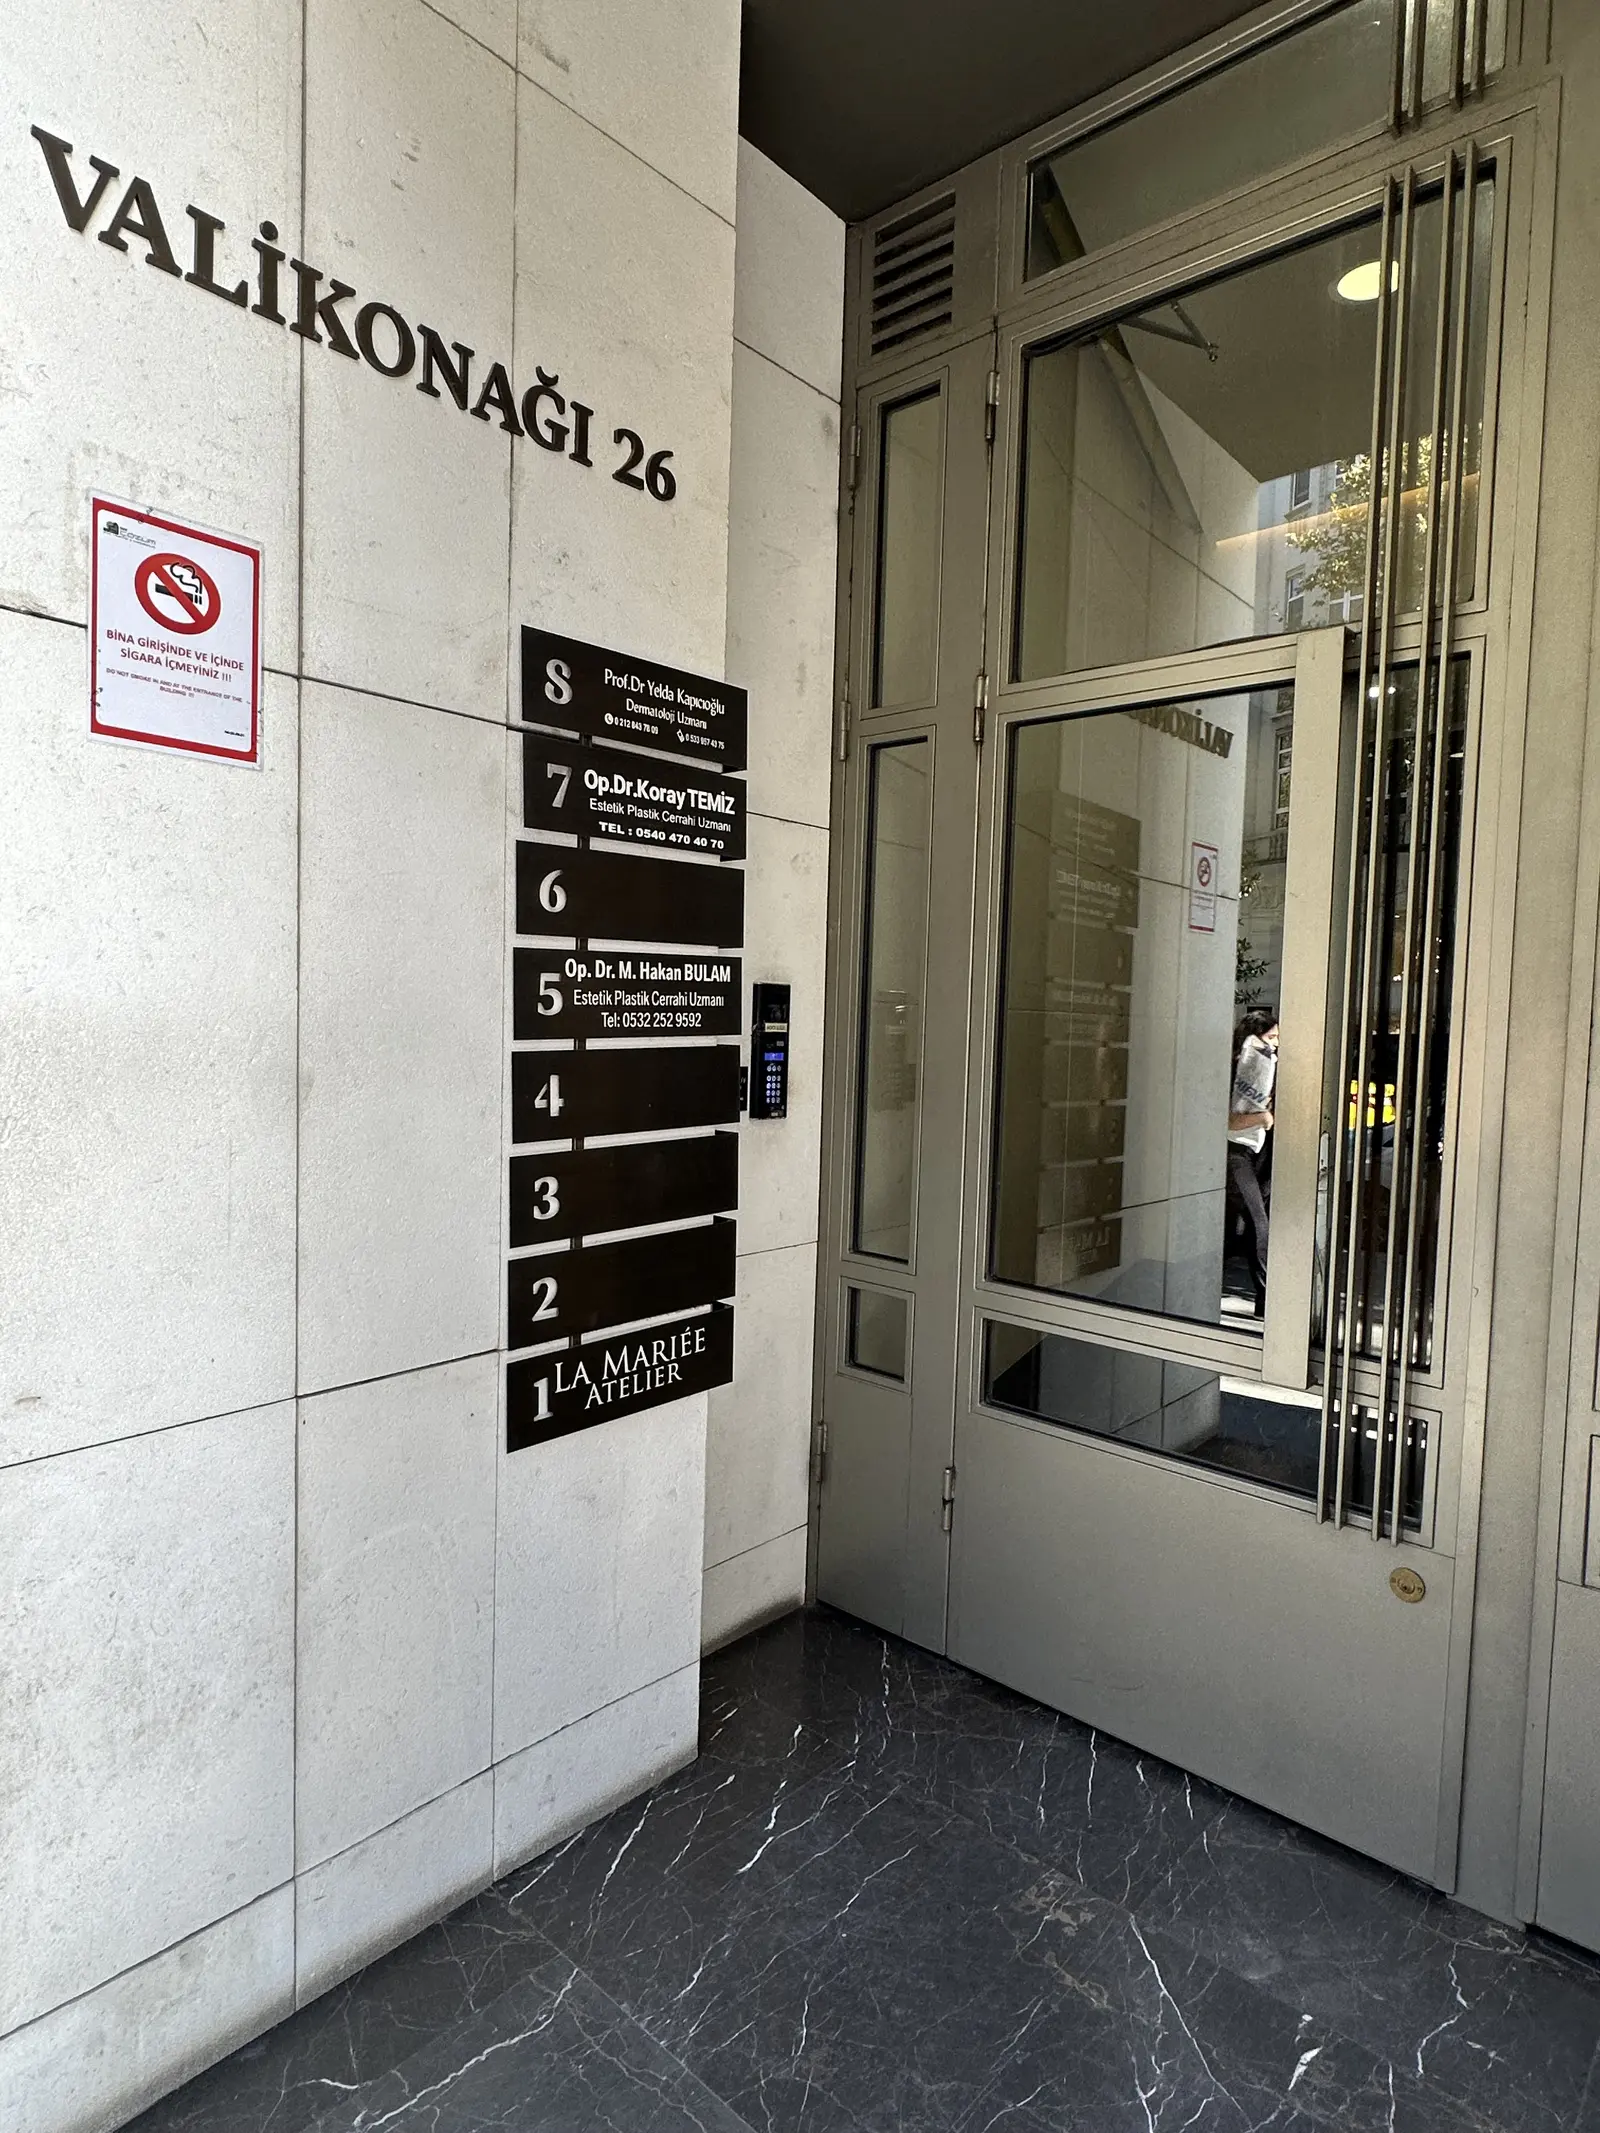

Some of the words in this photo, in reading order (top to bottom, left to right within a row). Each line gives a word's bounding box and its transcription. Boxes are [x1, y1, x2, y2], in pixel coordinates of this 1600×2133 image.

[31, 125, 594, 467] VALİKONAĞI
[611, 428, 677, 501] 26
[106, 628, 135, 644] BİNA
[138, 636, 192, 658] GİRİŞİNDE
[195, 650, 208, 662] VE
[211, 653, 245, 671] İÇİNDE
[121, 647, 163, 666] SİGARA
[166, 656, 219, 680] İÇMEYİNİZ
[604, 667, 646, 694] Prof.Dr
[647, 679, 674, 701] Yelda
[677, 688, 726, 717] Kapıcıoğlu
[626, 698, 676, 724] Dermatoloji
[677, 710, 708, 730] Uzmanı
[547, 762, 573, 808] 7
[686, 788, 736, 815] TEMİZ
[589, 797, 625, 815] Estetik
[627, 804, 660, 821] Plastik
[662, 811, 696, 827] Cerrahi
[698, 817, 731, 833] Uzmanı
[599, 821, 625, 835] TEL
[636, 827, 666, 841] 0540
[668, 833, 690, 845] 470
[693, 836, 708, 847] 40
[711, 839, 725, 850] 70
[539, 869, 568, 913] 6
[565, 958, 592, 982] Op.
[595, 959, 616, 979] Dr.
[619, 960, 637, 980] M.
[640, 961, 682, 981] Hakan
[684, 963, 731, 983] BULAM
[537, 972, 563, 1016] 5
[573, 989, 612, 1006] Estetik
[614, 990, 650, 1006] Plastik
[651, 990, 688, 1007] Cerrahi
[689, 992, 724, 1007] Uzmanı
[601, 1011, 621, 1028] Tel:
[622, 1012, 651, 1028] 0532
[653, 1012, 674, 1028] 252
[675, 1012, 702, 1028] 9592
[534, 1074, 565, 1117] 4
[533, 1176, 561, 1220] 3
[531, 1276, 560, 1322] 2
[554, 1360, 592, 1394] LA
[601, 1326, 706, 1381] MARIÉE
[533, 1377, 554, 1422] 1
[584, 1363, 683, 1410] ATELIER
